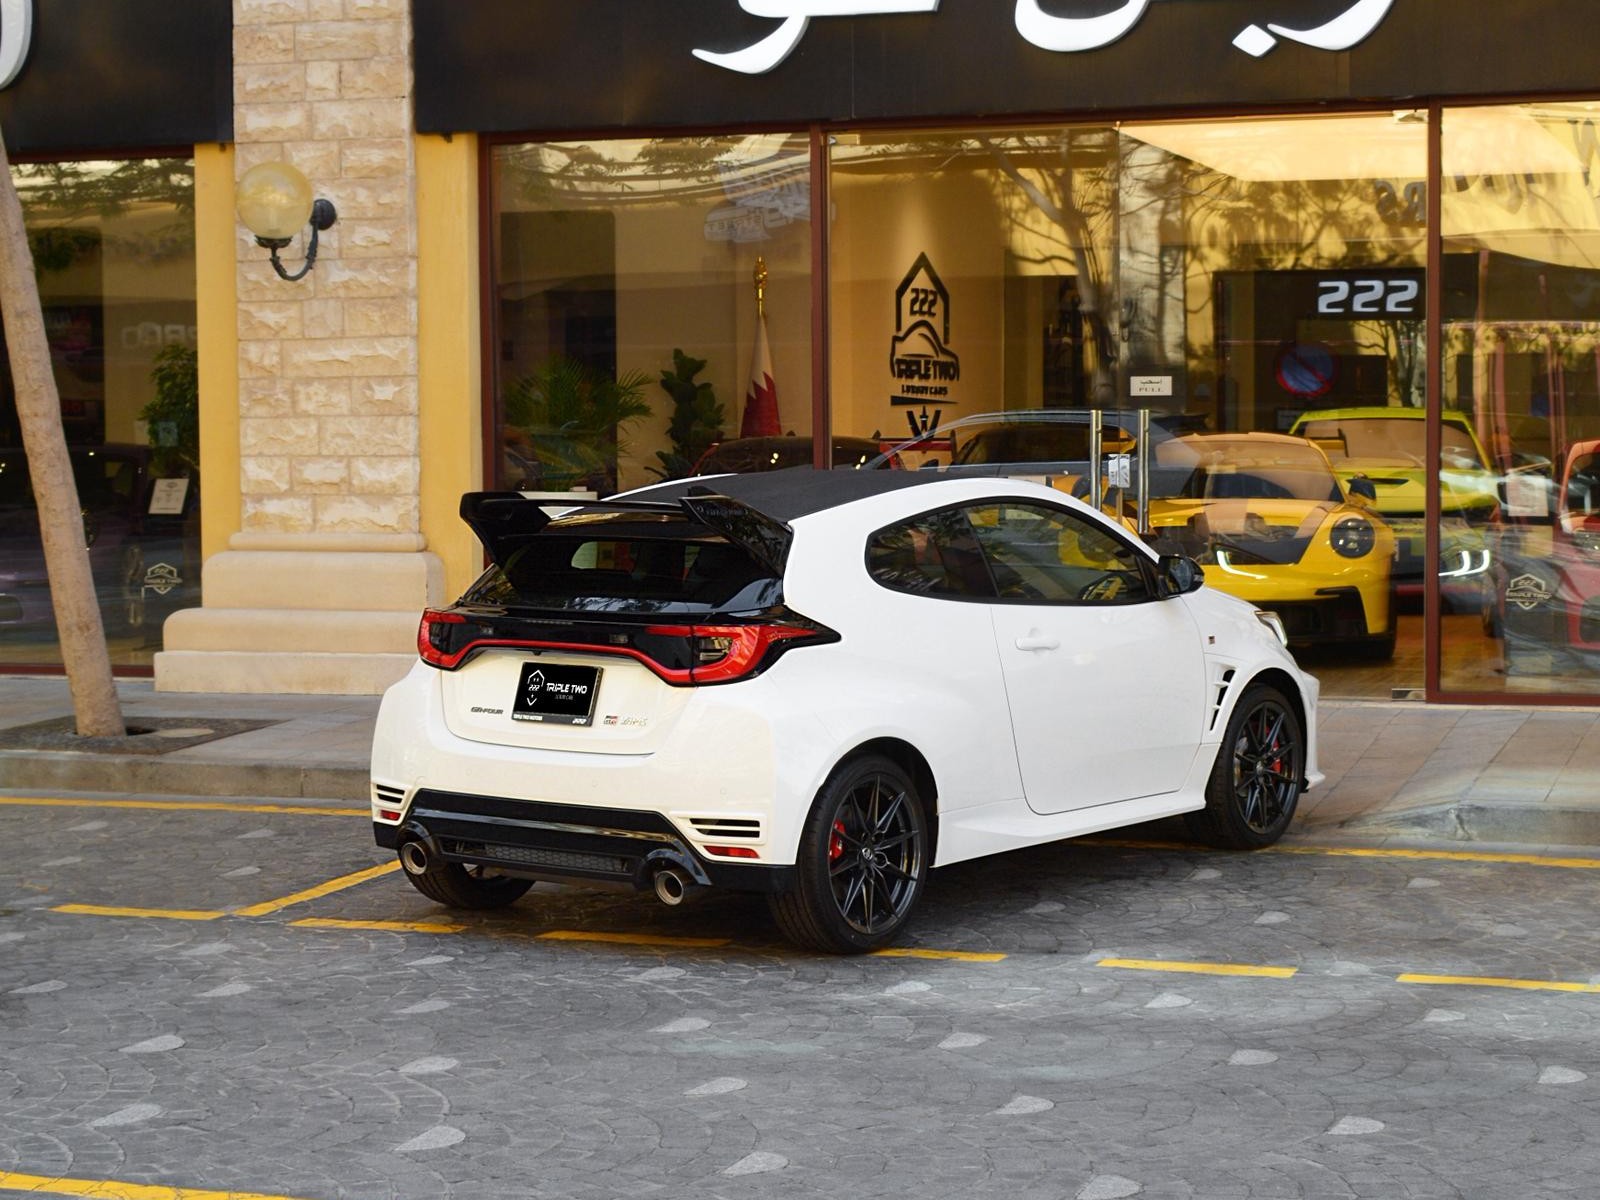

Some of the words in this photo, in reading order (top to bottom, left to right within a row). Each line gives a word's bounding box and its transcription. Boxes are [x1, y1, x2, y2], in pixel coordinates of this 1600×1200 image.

[909, 287, 938, 318] 222
[1317, 279, 1419, 313] 222
[895, 358, 932, 381] TRIPLE
[932, 359, 957, 382] TWO
[901, 384, 929, 396] LUXURY
[929, 385, 948, 397] CARS
[546, 682, 570, 693] TRIPLE
[570, 684, 588, 694] TWO
